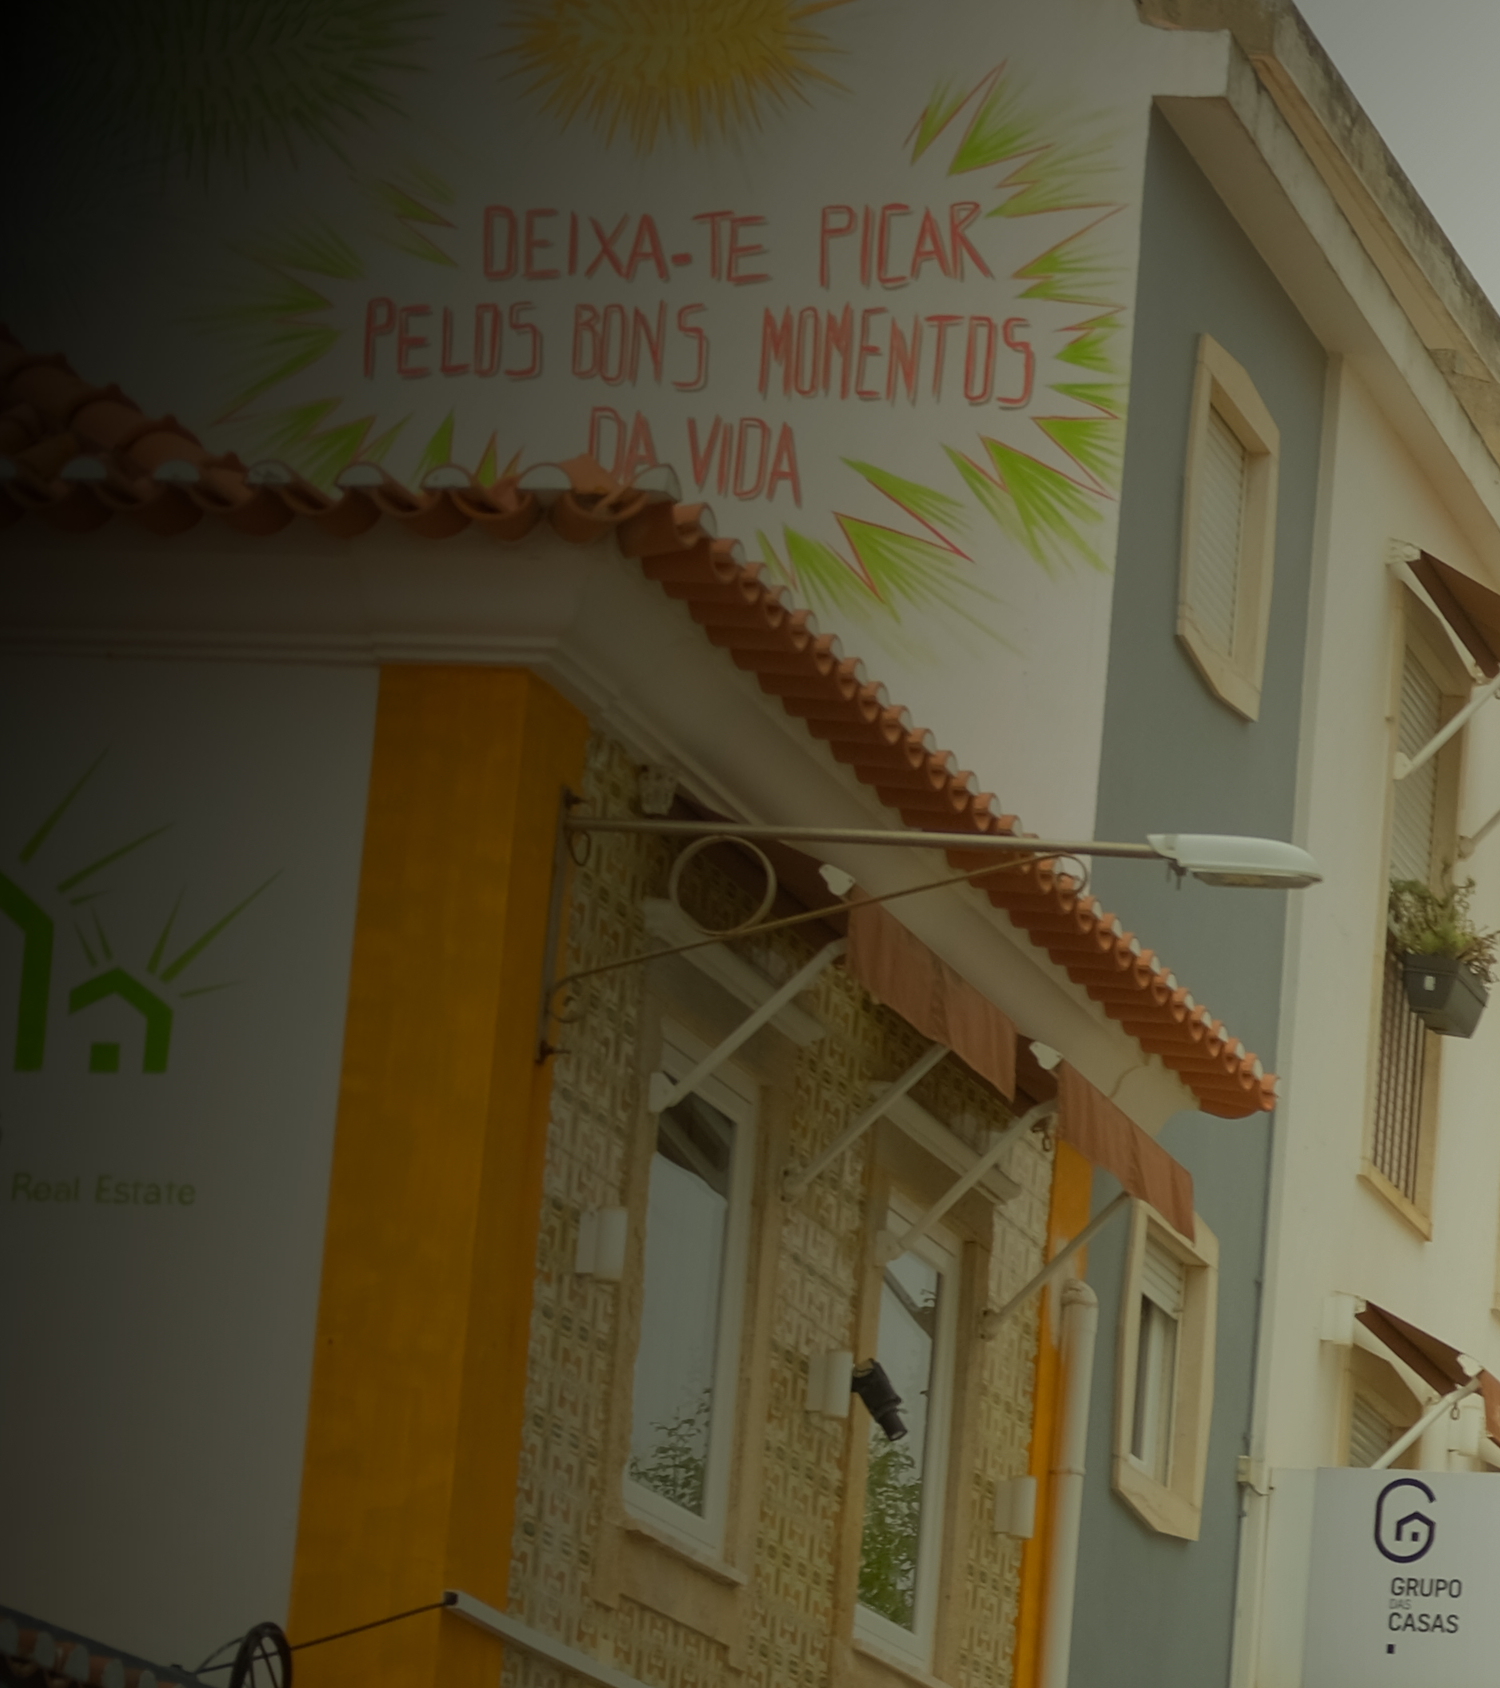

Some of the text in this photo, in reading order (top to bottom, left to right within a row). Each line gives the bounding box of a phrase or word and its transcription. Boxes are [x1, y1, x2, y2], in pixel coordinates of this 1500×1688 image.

[483, 200, 994, 288] DEIXA-TE PICAR
[362, 297, 1036, 405] PELOS BONS MOMENTOS
[588, 406, 804, 506] DA VIDA
[11, 1172, 196, 1206] Real Estate
[1391, 1577, 1462, 1598] GRUPO
[1388, 1612, 1459, 1633] CASAS
